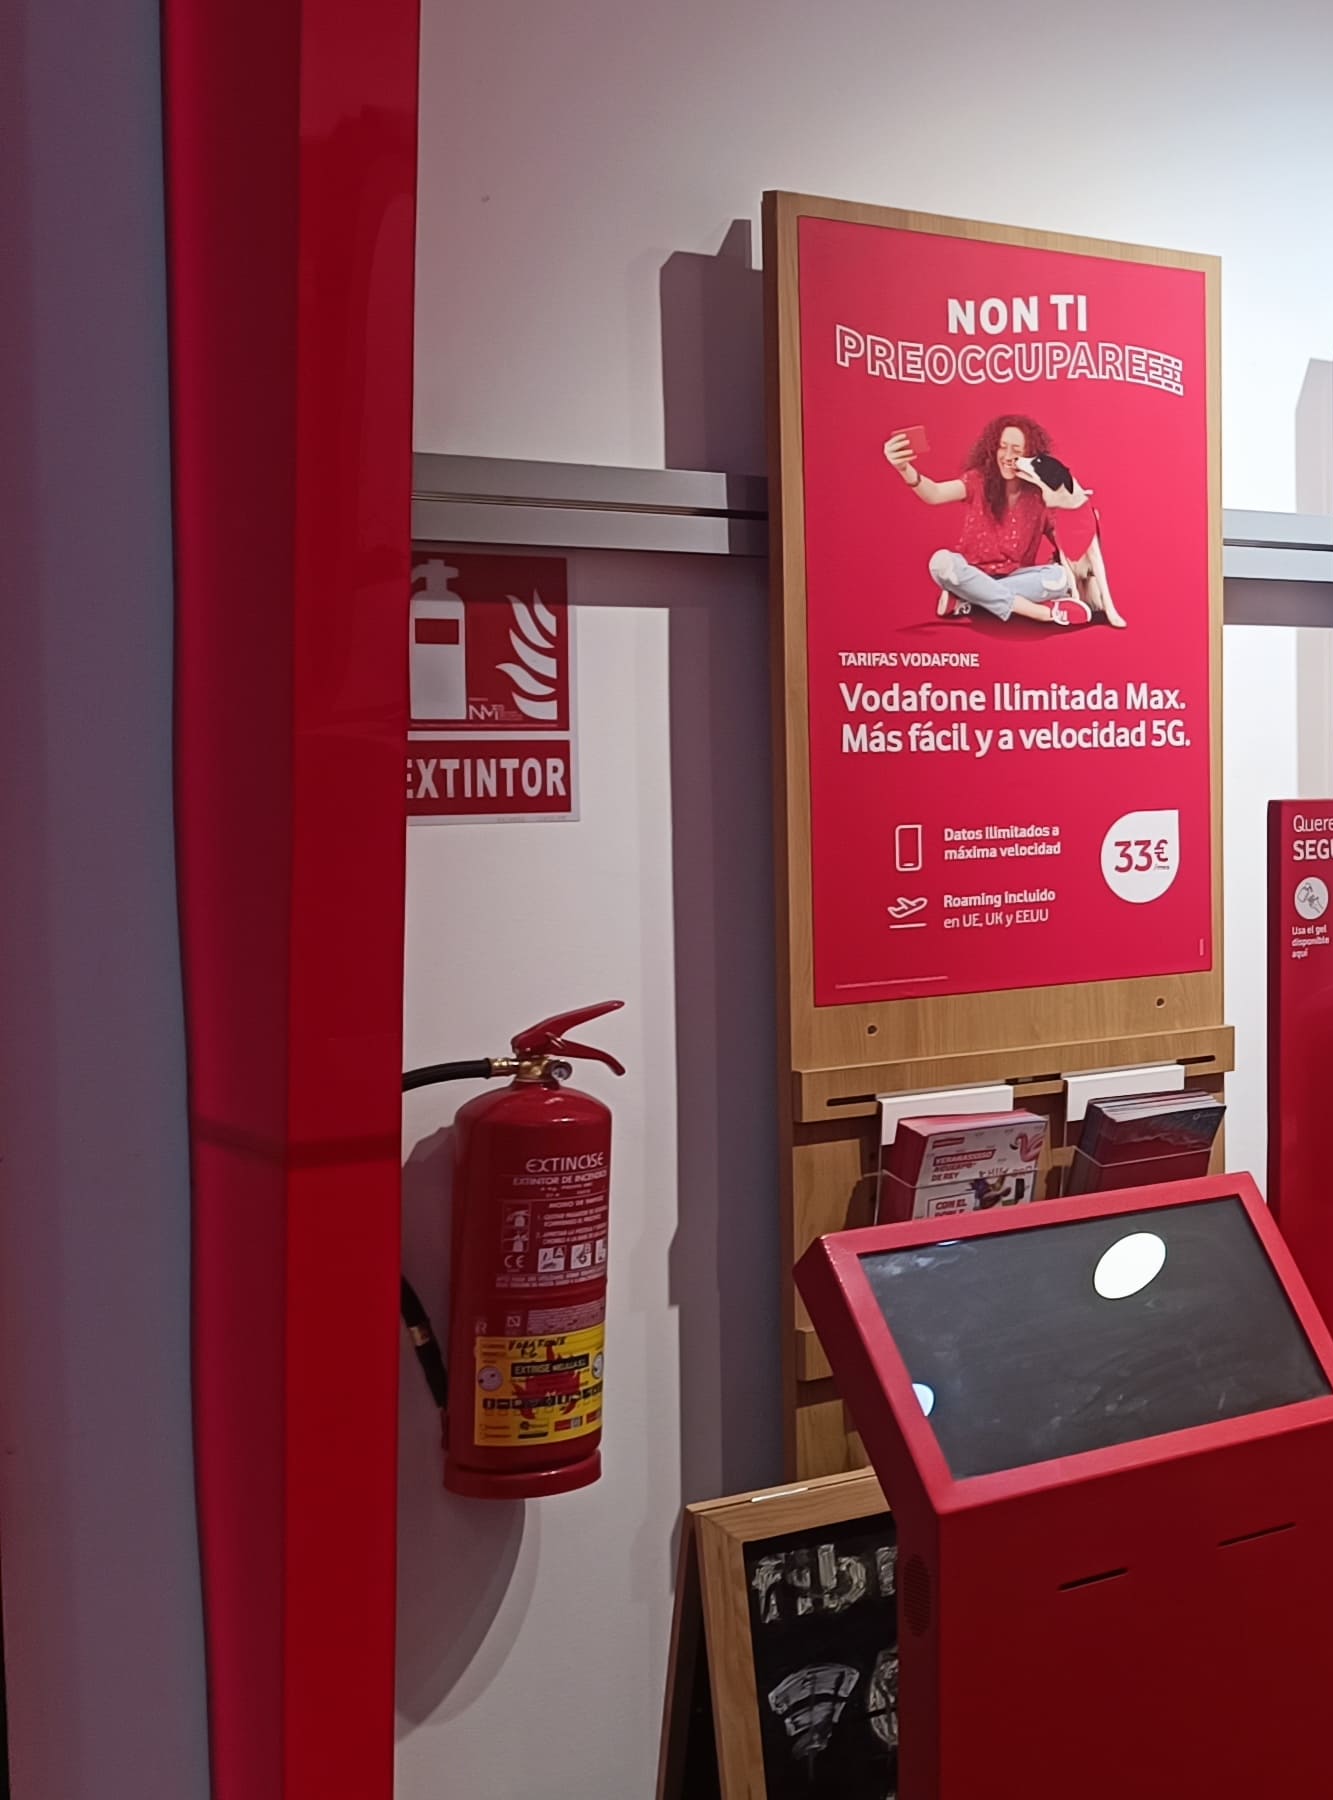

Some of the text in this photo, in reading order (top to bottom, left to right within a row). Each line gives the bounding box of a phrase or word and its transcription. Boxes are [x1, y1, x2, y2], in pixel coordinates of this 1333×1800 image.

[948, 294, 1087, 335] NON TI
[839, 652, 980, 667] TARIFAS VODAFONE
[839, 682, 1187, 713] Vodafone Ilimitada Max.
[842, 720, 1191, 758] Más fácil y a velocidad 5G.
[944, 827, 983, 842] Datos
[1051, 826, 1060, 838] a
[944, 842, 1062, 861] máxima velocidad
[1114, 839, 1168, 873] 33€
[943, 888, 1056, 909] Roaming incluido
[943, 909, 1049, 929] en UE, UK y EEUU
[1292, 924, 1327, 936] Usa el gel
